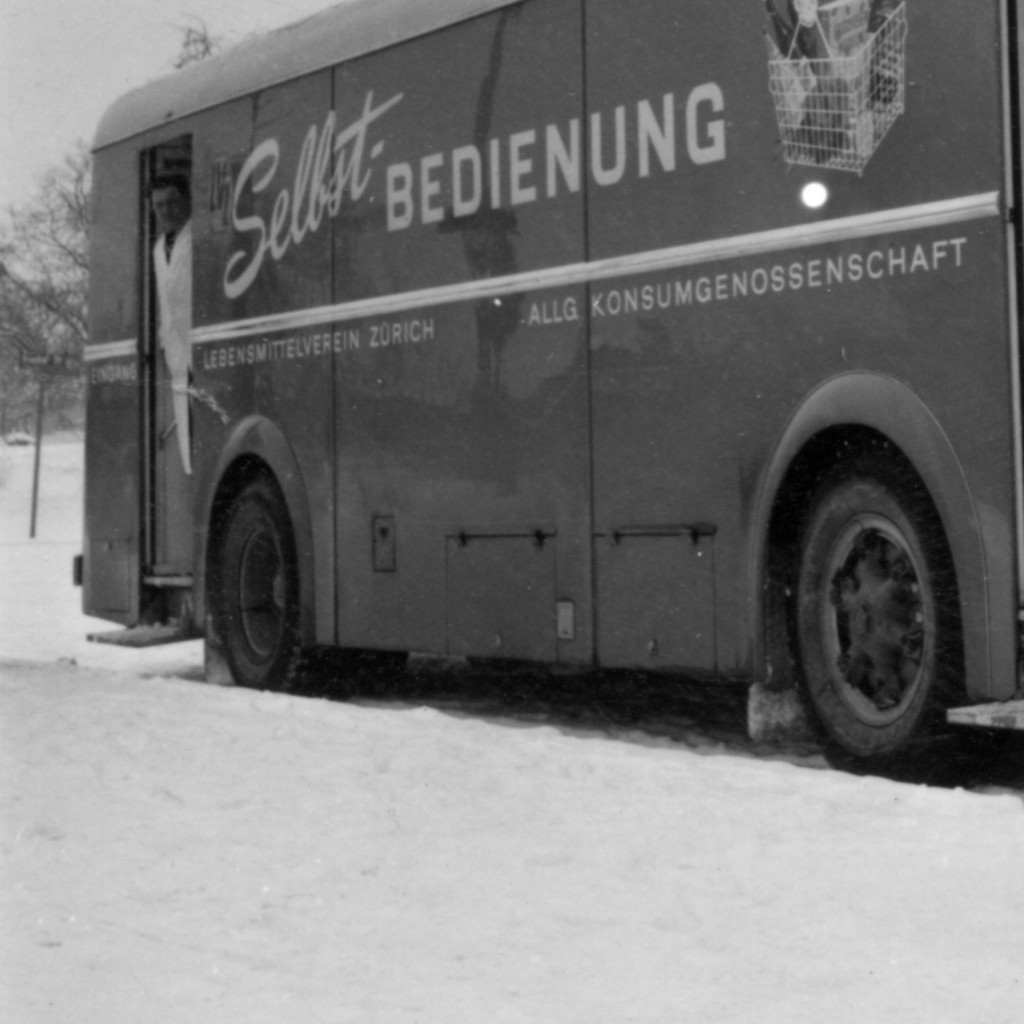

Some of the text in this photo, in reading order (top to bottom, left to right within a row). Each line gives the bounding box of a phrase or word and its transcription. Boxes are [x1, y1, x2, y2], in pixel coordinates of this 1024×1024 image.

[386, 82, 726, 231] BEDIENUNG
[591, 237, 967, 317] KONSUMGENOSSENSCHAFT
[203, 319, 434, 370] LEBENSMITTELVEREIN ZÜRICH
